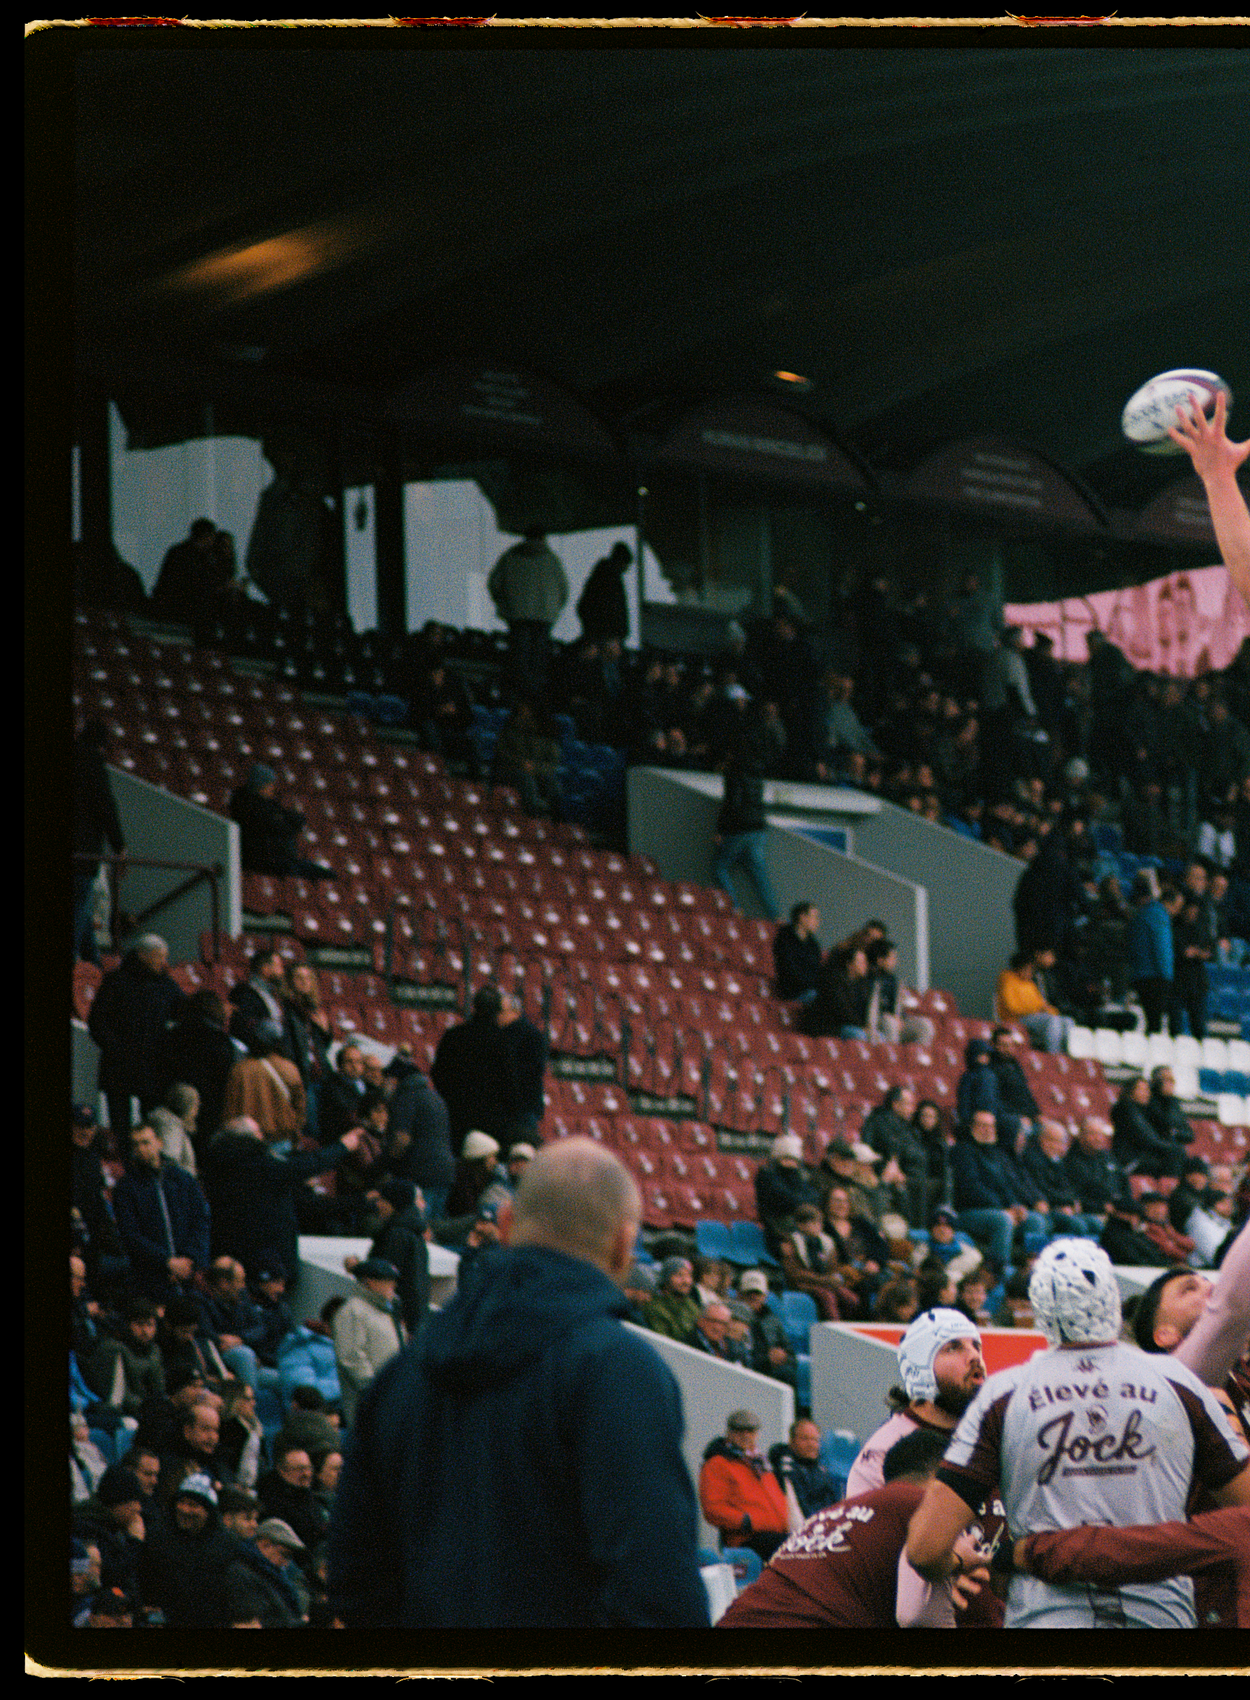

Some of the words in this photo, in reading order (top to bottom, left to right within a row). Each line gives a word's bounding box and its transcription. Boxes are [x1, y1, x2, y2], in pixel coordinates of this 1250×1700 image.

[1028, 1377, 1110, 1413] Élevé
[1119, 1382, 1158, 1404] au
[1036, 1408, 1157, 1486] Jock
